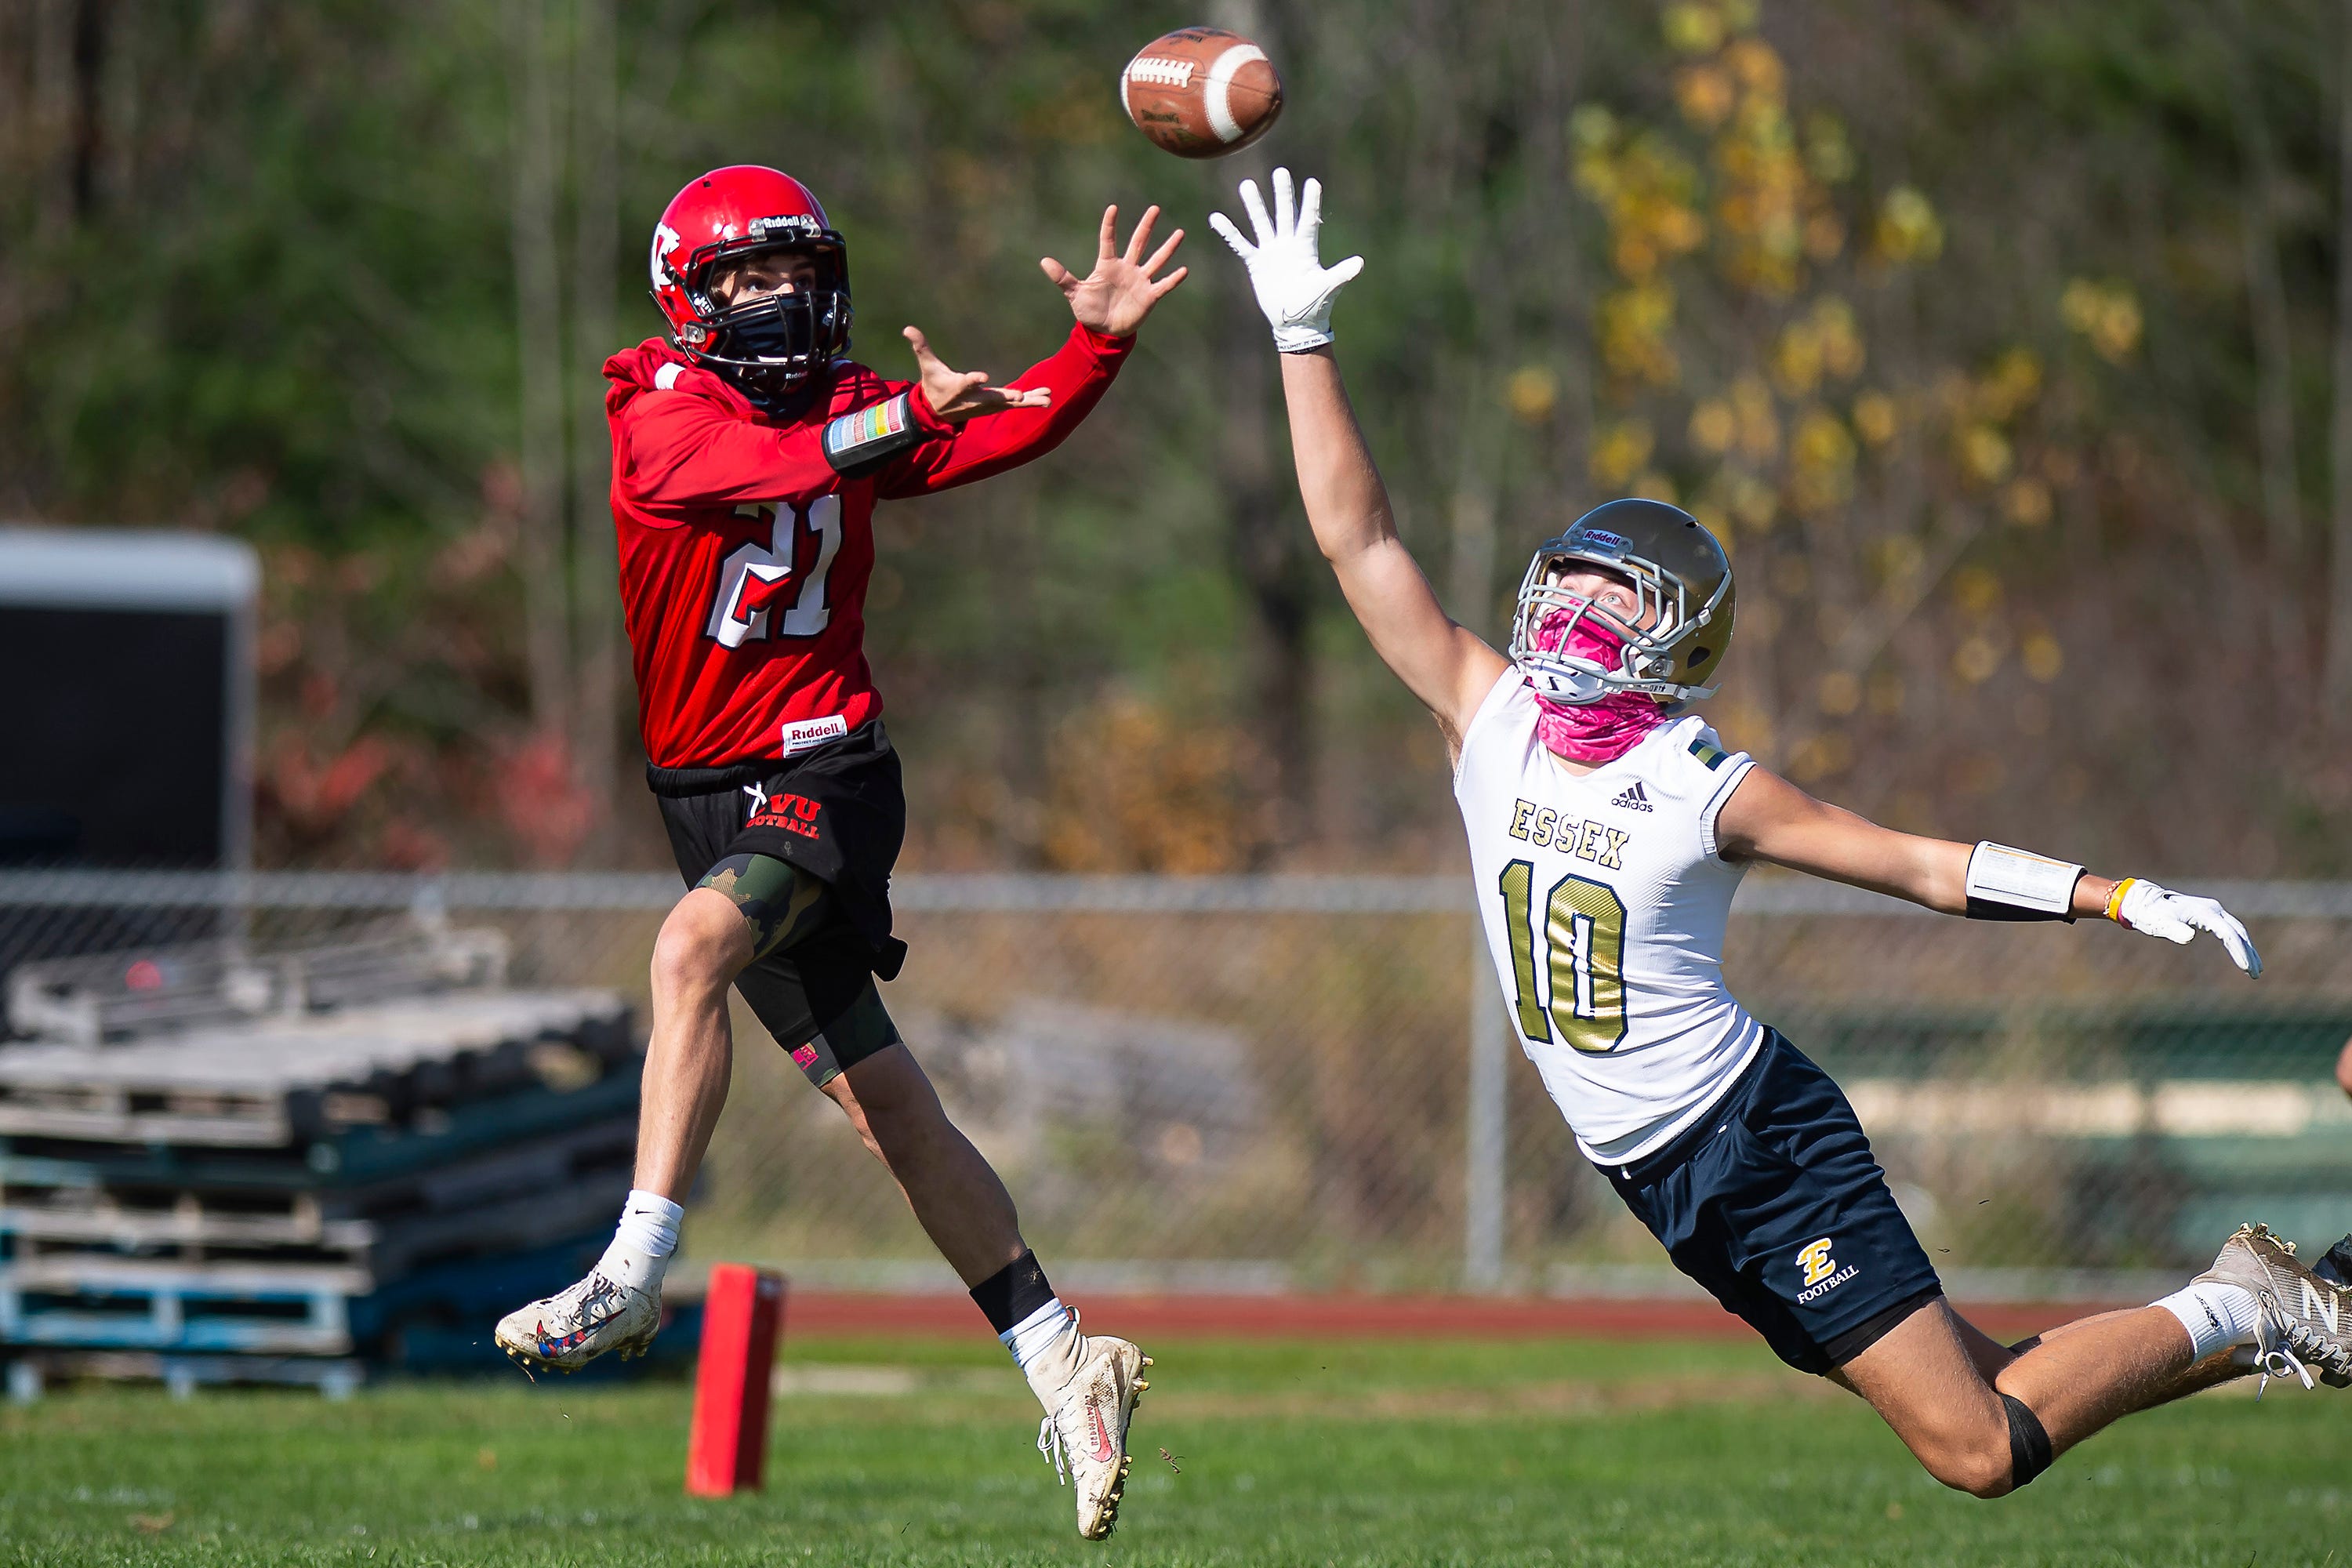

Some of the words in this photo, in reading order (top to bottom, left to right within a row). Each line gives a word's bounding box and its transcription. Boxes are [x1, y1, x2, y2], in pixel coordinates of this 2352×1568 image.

[763, 216, 800, 228] Riddell
[1584, 530, 1621, 546] Riddell
[702, 493, 843, 648] 21
[792, 723, 841, 740] Riddell
[1611, 798, 1653, 813] adidas
[1508, 798, 1630, 870] ESSEX
[1499, 858, 1629, 1053] 10
[1796, 1265, 1860, 1305] FOOTBALL
